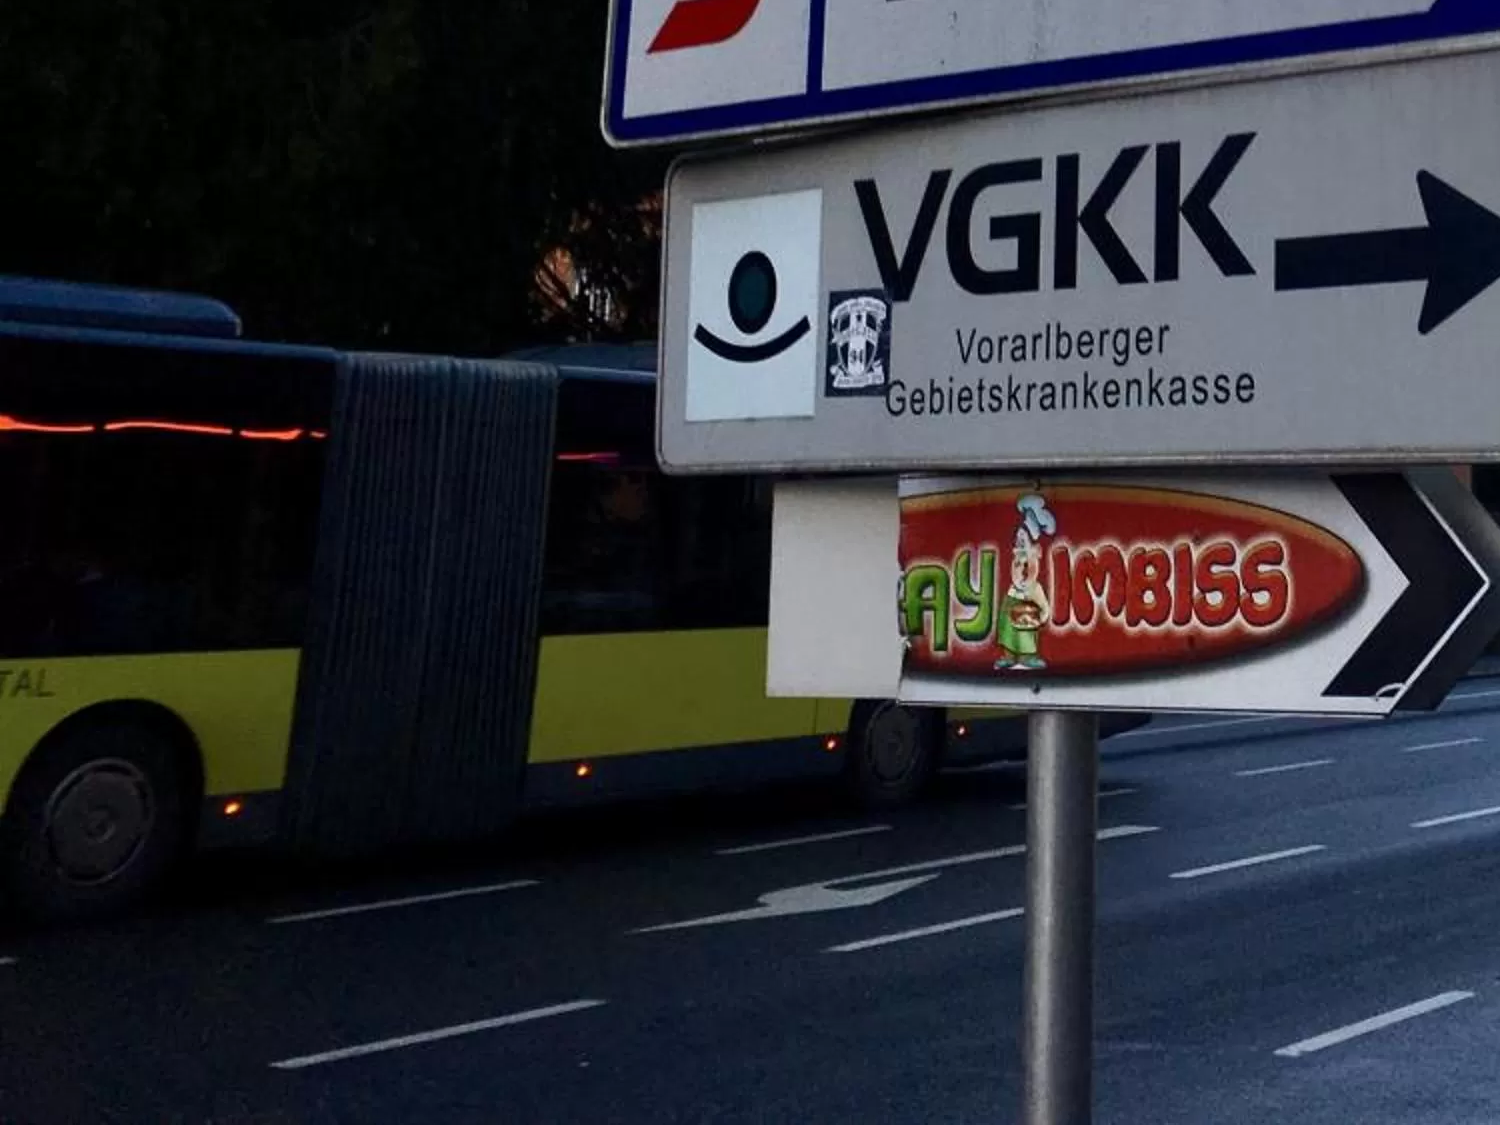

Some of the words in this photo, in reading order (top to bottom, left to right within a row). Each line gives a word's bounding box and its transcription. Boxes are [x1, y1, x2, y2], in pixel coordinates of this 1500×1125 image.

[854, 133, 1257, 303] VGKK
[956, 321, 1170, 367] Vorarlberger
[885, 370, 1255, 417] Gebietskrankenkasse
[898, 548, 997, 653] AY
[1052, 541, 1291, 630] IMBISS
